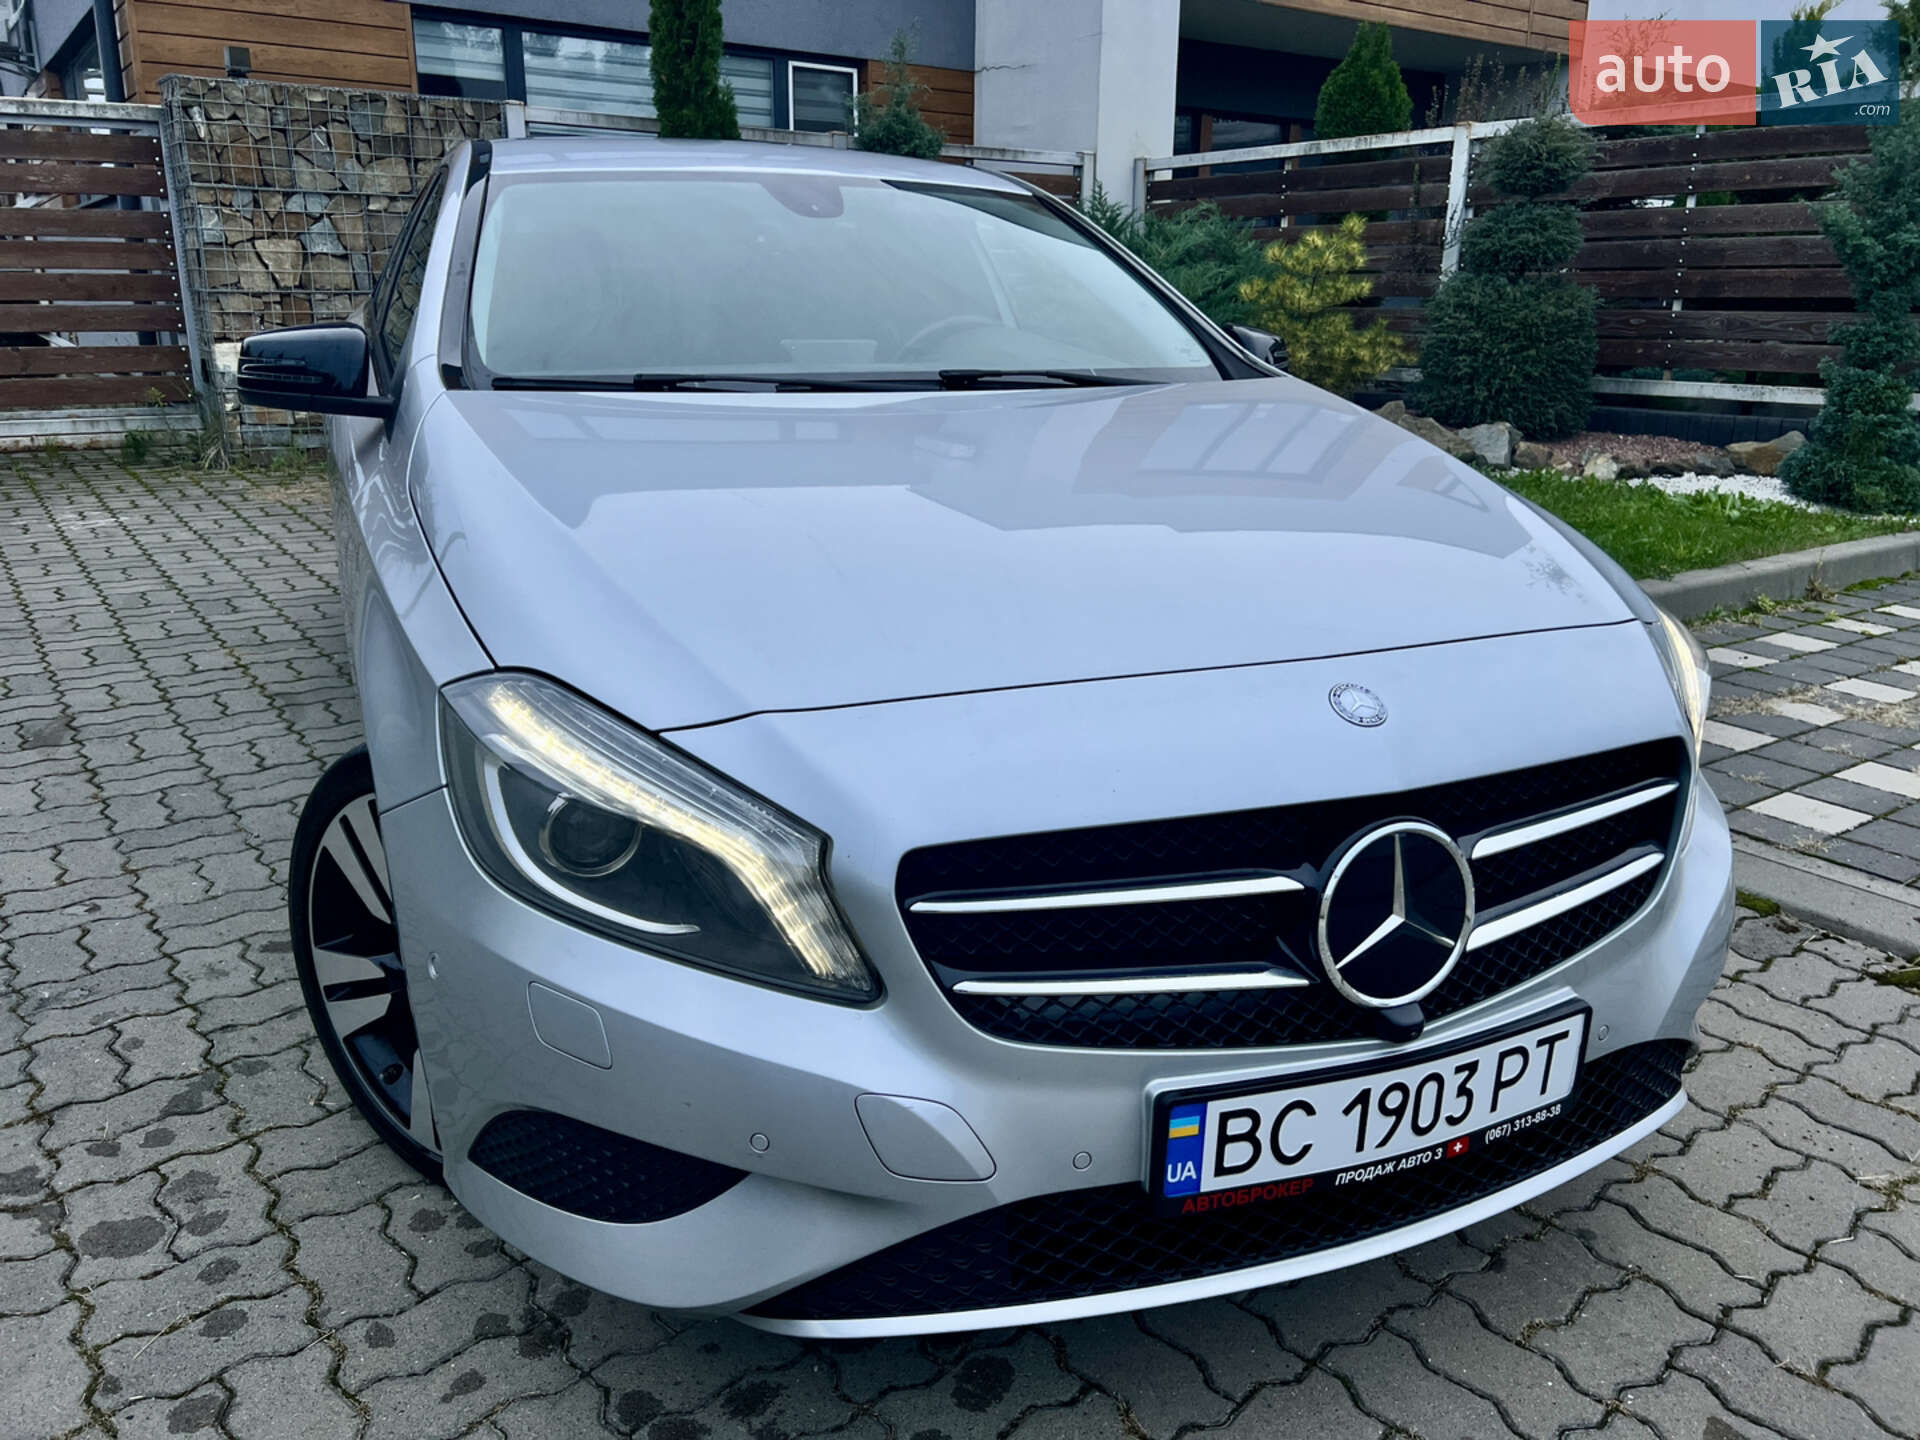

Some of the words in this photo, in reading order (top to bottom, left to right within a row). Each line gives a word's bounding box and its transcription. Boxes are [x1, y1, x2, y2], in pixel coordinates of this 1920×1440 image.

[1213, 1099, 1317, 1178] BC
[1341, 1058, 1480, 1153] 1903
[1489, 1030, 1570, 1114] PT
[1167, 1160, 1197, 1184] UA
[1335, 1161, 1396, 1186] ПРОДАЖ
[1397, 1151, 1432, 1171] АВТО
[1485, 1123, 1511, 1144] (067)
[1513, 1103, 1562, 1132] 313-88-38
[1182, 1178, 1314, 1214] АВТОБРОКЕР
